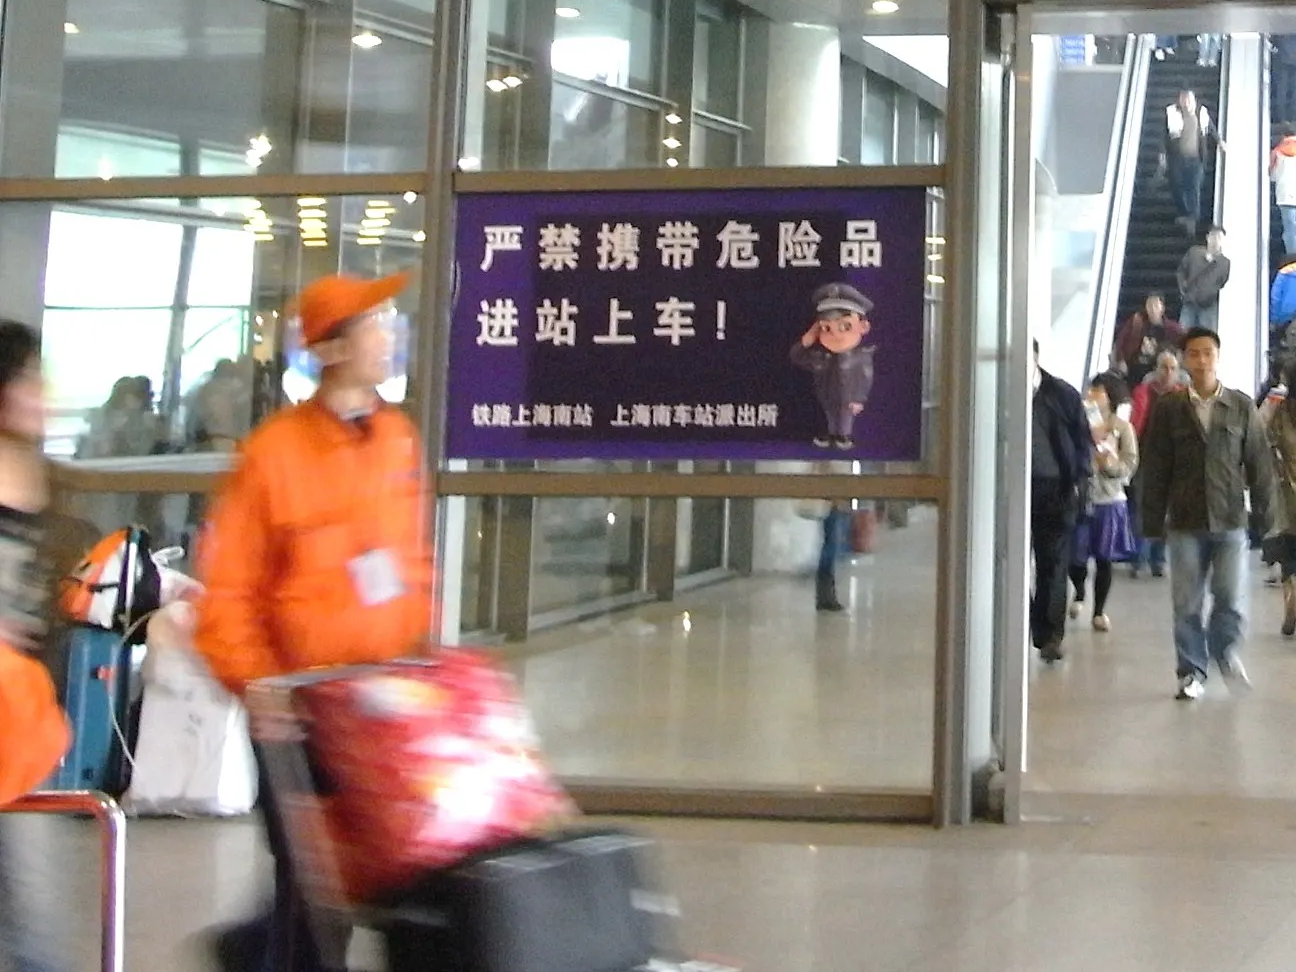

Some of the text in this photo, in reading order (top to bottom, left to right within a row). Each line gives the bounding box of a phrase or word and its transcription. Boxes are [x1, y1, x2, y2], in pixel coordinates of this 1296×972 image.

[480, 219, 882, 272] 严禁携带危险品
[472, 402, 778, 428] 铁路上海南站 上海南车站派出所
